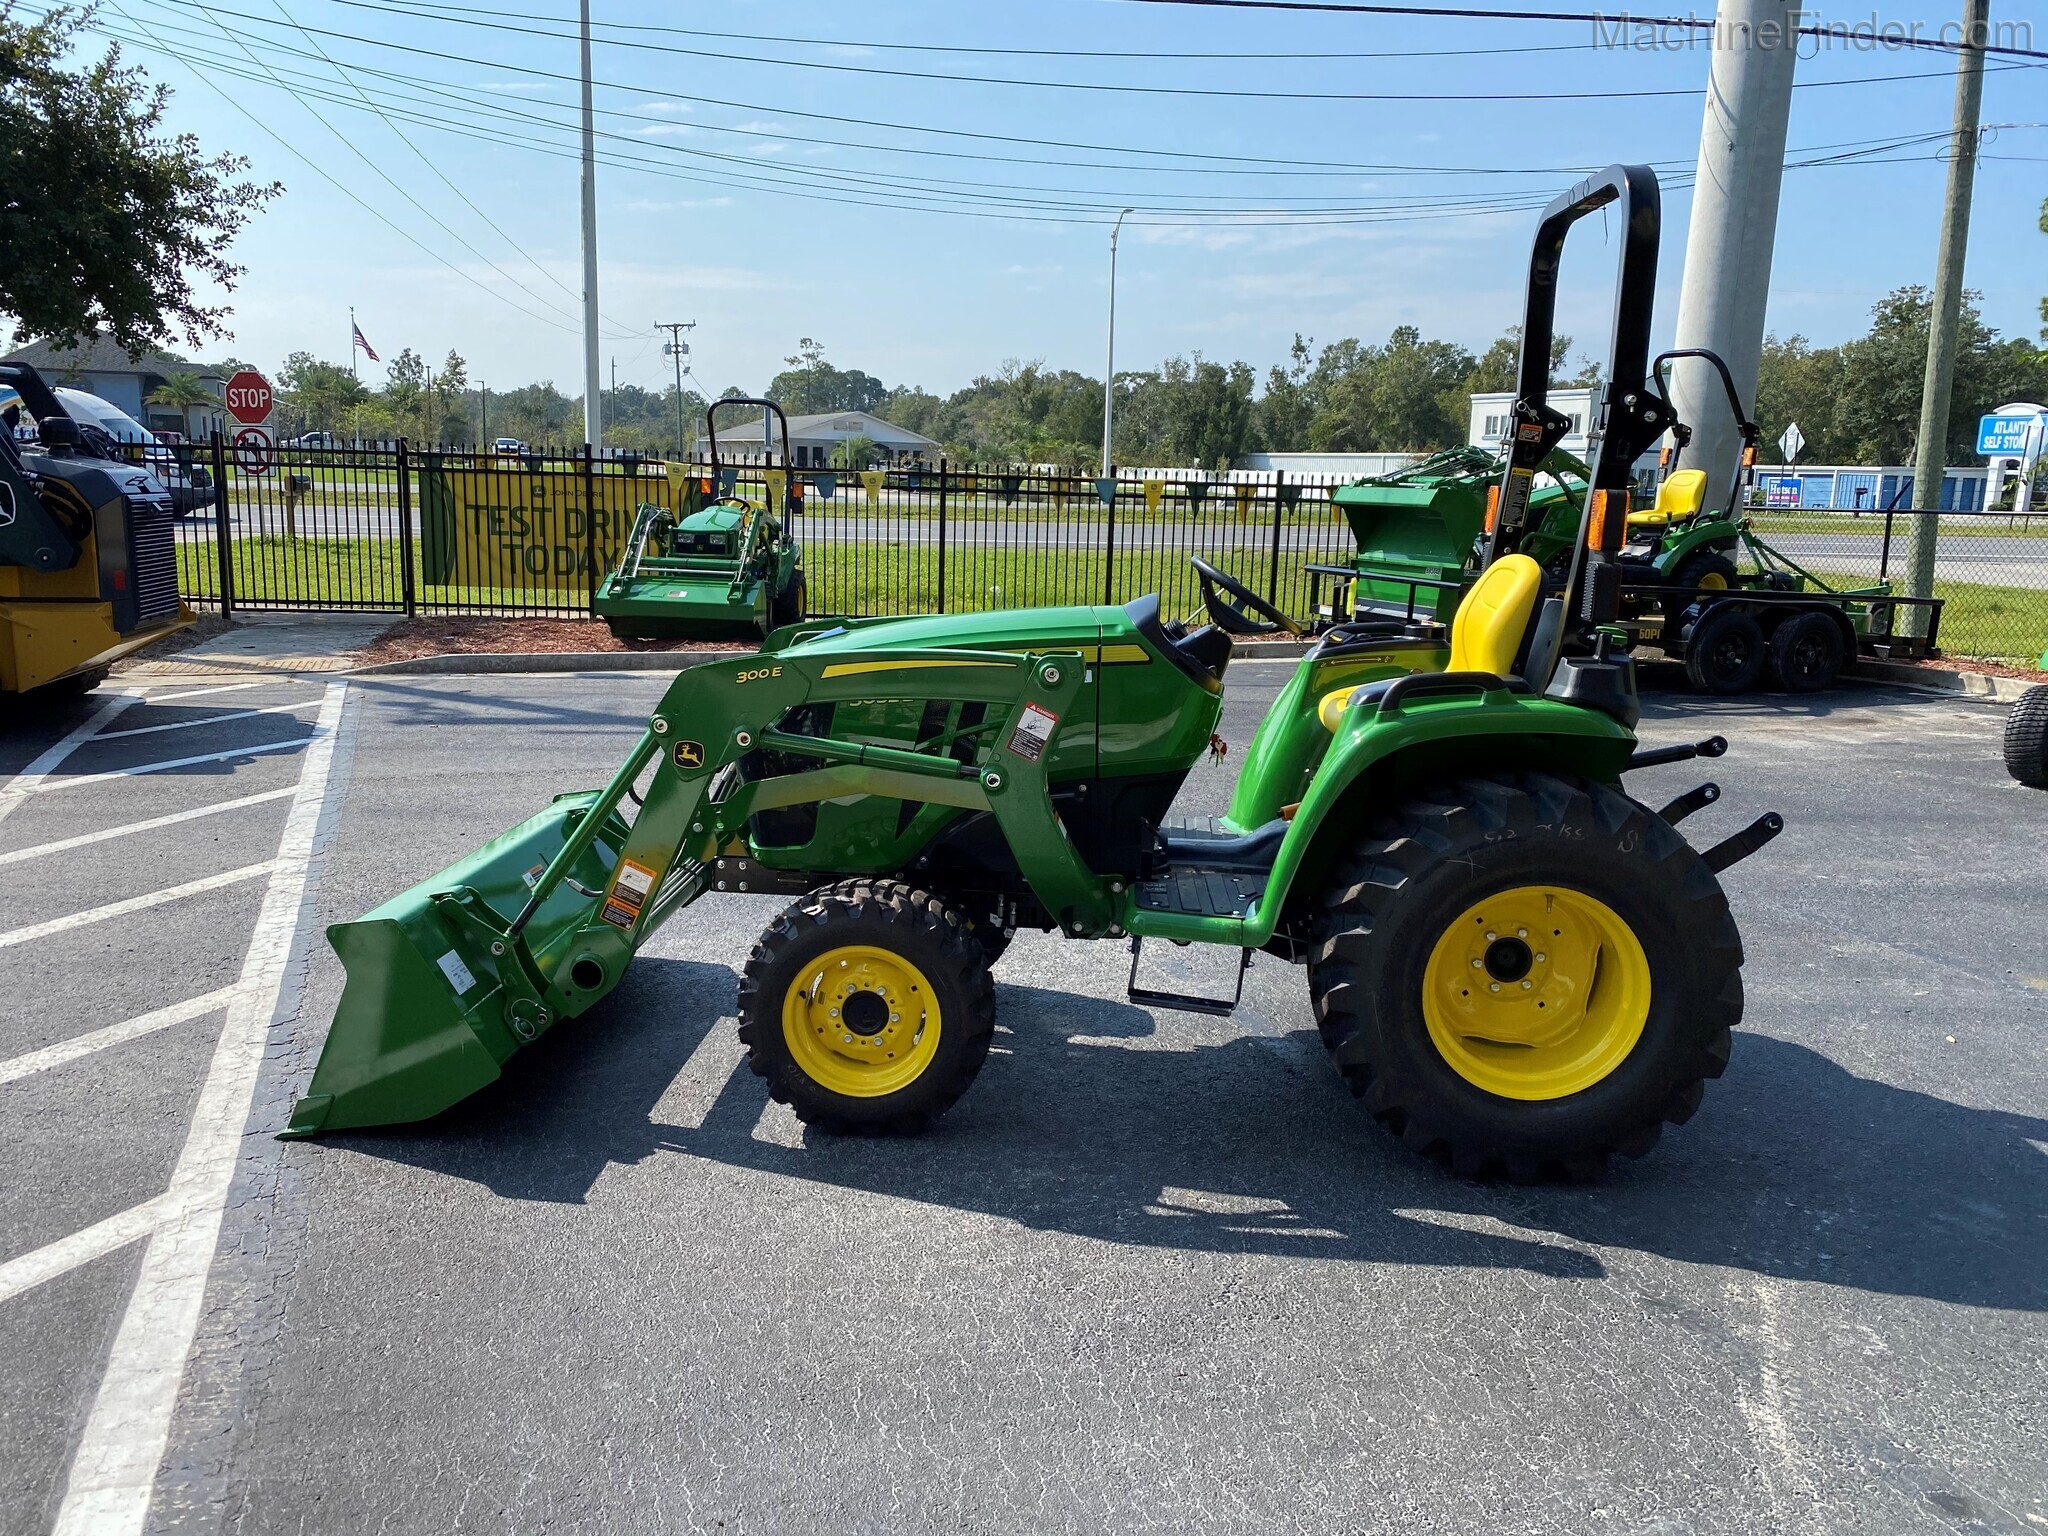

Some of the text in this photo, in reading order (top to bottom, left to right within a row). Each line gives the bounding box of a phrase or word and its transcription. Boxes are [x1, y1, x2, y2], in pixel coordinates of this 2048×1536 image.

[229, 388, 269, 408] STOP
[1993, 420, 2028, 434] ATLANT
[1983, 435, 2002, 449] SELF
[550, 489, 603, 498] JOHN DERE
[466, 504, 553, 538] TEST
[502, 544, 621, 577] TODAY
